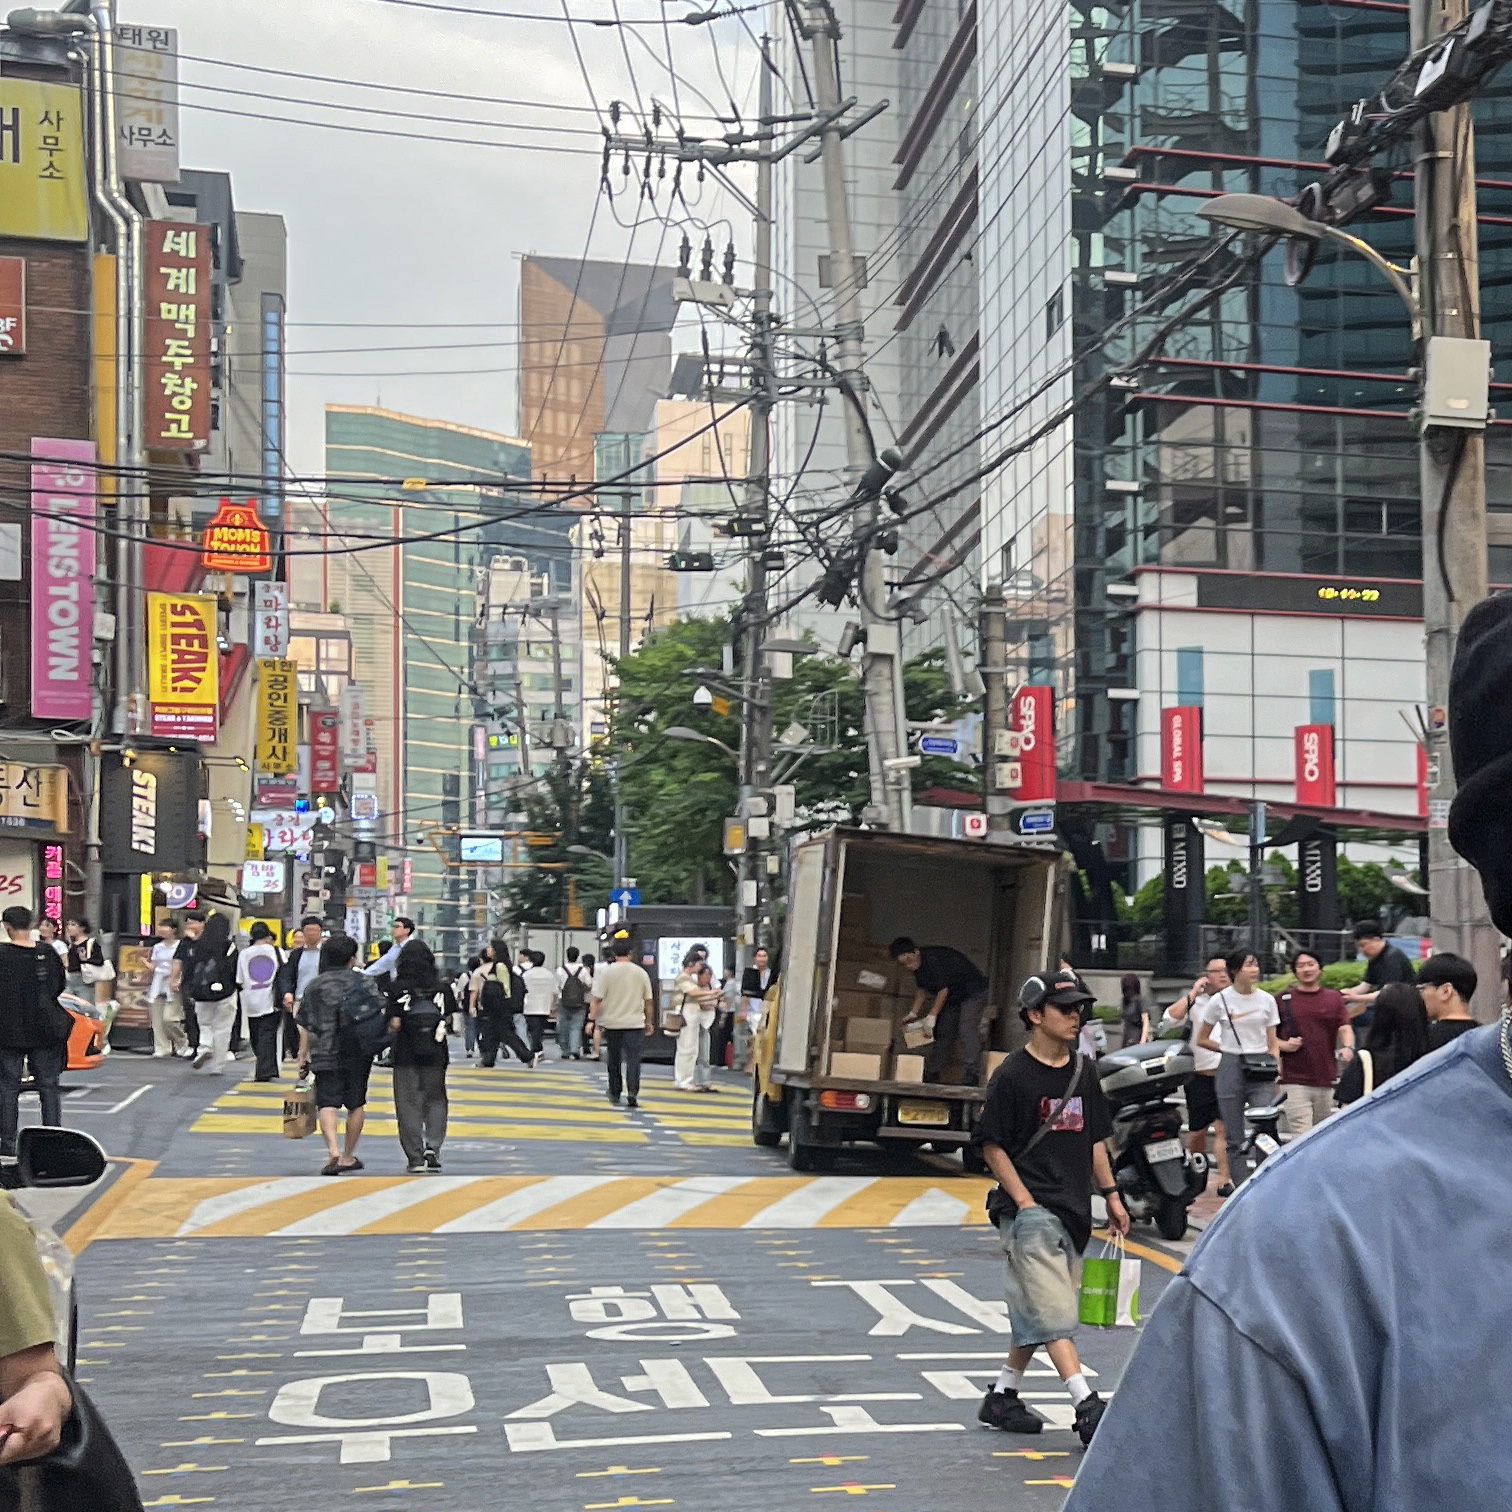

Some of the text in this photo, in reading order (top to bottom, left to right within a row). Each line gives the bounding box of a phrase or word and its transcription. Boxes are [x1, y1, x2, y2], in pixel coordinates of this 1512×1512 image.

[39, 110, 65, 180] 사무소
[120, 125, 176, 148] 사무소
[159, 230, 199, 439] 세계맥주창고
[170, 603, 209, 693] STEAK!
[267, 674, 289, 763] 공인중개사
[1020, 696, 1036, 751] SPAO
[1303, 732, 1319, 782] SPAO
[130, 768, 157, 855] STEAK!
